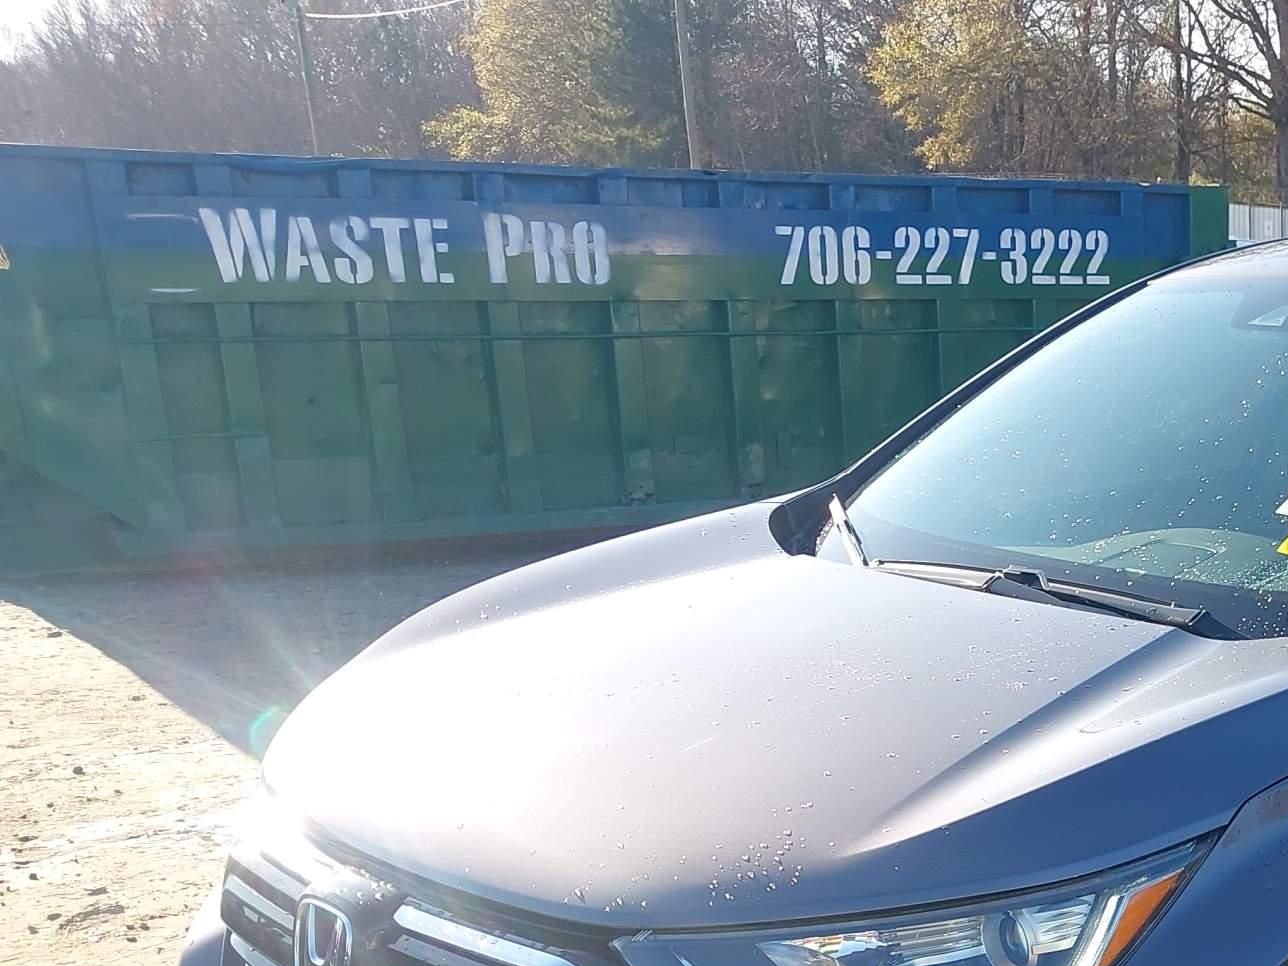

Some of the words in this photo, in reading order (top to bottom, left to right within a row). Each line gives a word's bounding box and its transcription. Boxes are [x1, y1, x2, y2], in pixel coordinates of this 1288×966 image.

[199, 207, 455, 284] WASTE
[482, 211, 611, 285] PRO
[775, 225, 1111, 287] 706-227-3222
